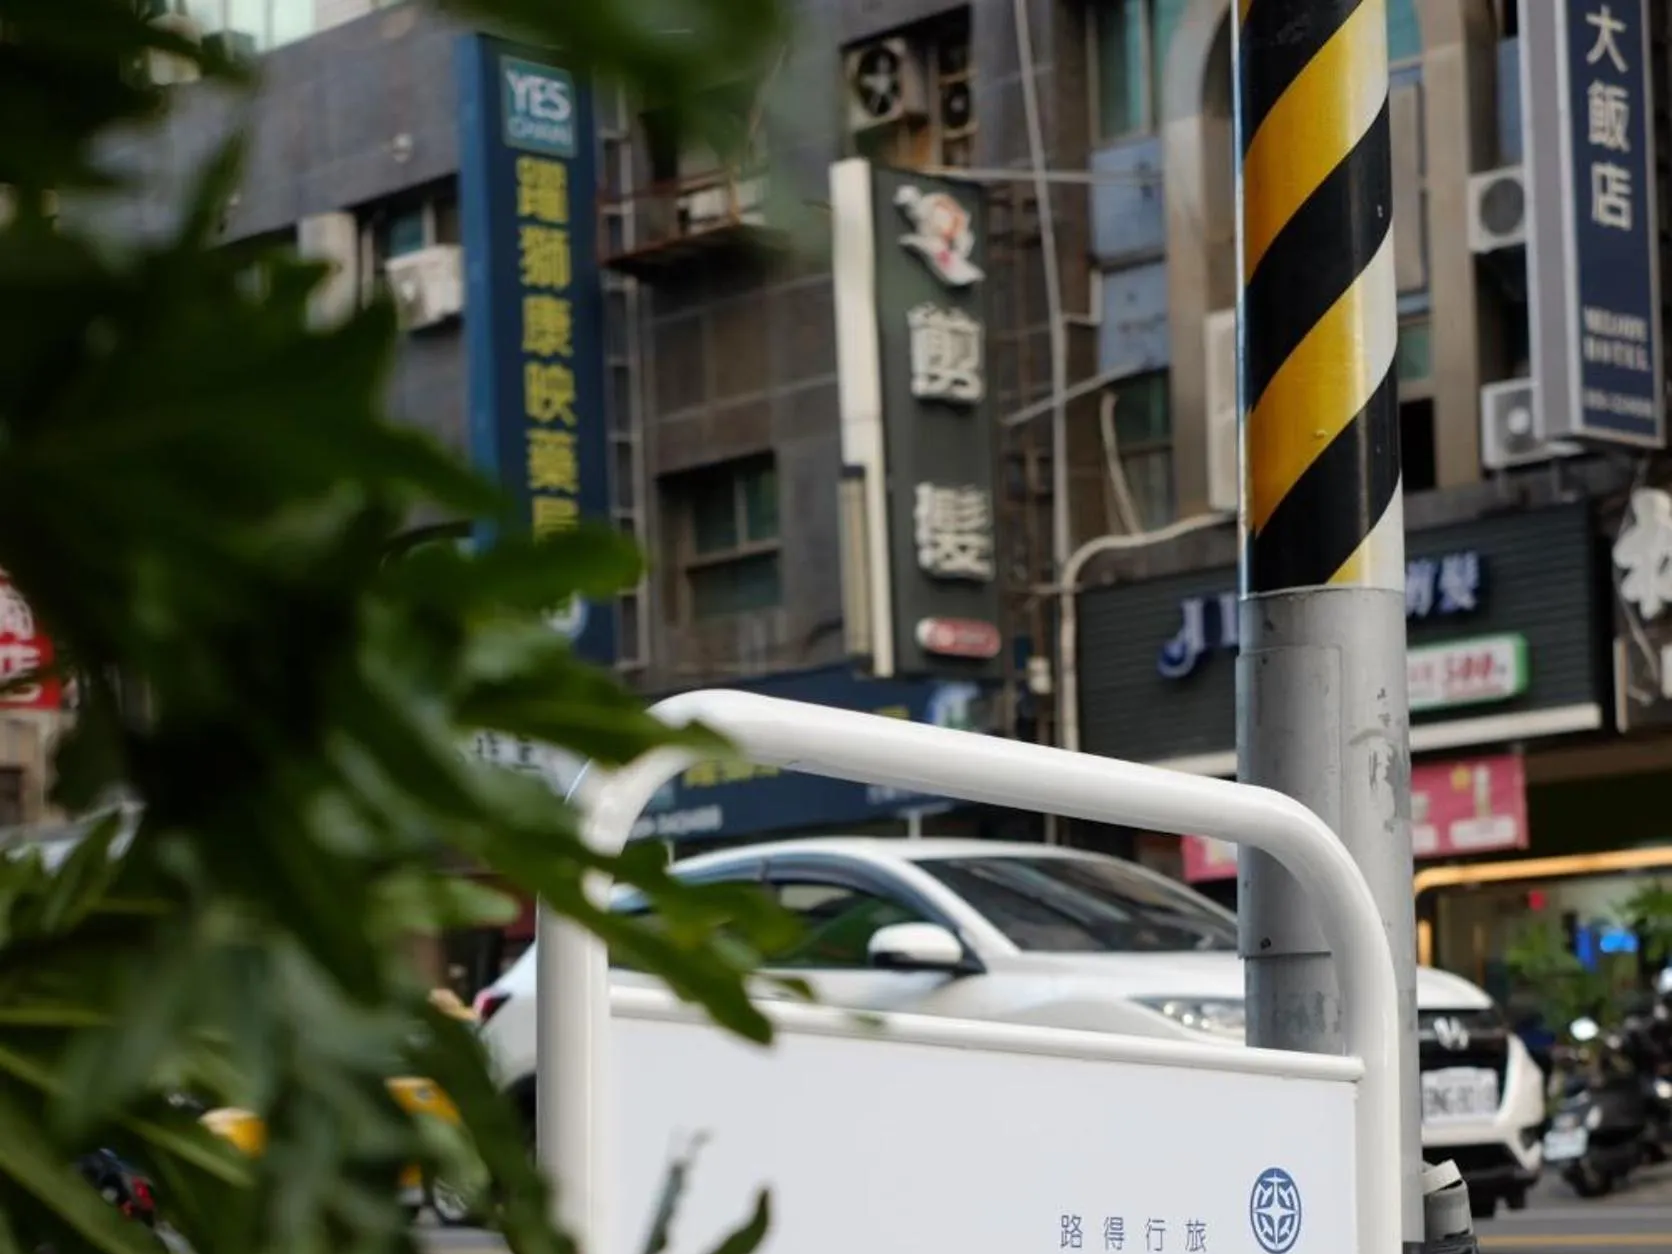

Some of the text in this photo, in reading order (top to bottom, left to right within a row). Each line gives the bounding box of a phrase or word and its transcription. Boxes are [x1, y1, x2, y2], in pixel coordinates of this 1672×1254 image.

[505, 68, 572, 122] YES
[1585, 4, 1632, 231] 大飯店
[1060, 1214, 1208, 1252] 路得行旅
